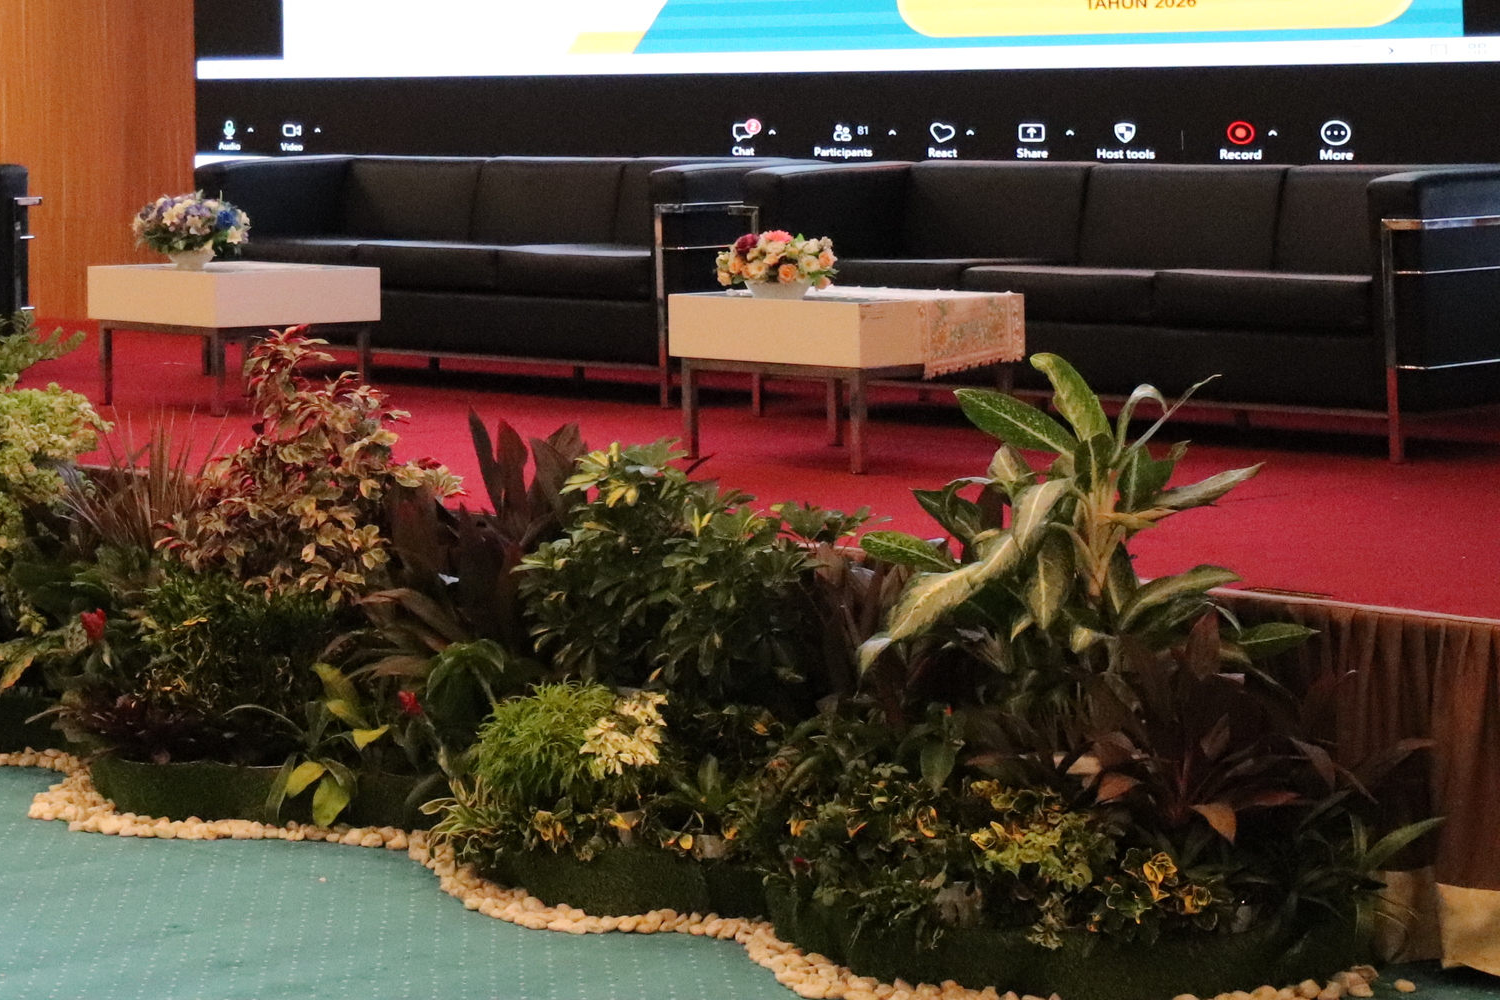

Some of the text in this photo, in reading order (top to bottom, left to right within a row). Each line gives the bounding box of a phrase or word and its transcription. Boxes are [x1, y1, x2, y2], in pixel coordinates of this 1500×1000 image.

[857, 126, 869, 135] 81
[218, 142, 241, 151] Audio
[280, 142, 303, 151] Video
[732, 146, 754, 157] Chat
[814, 146, 873, 158] Participants
[928, 147, 958, 158] React
[1016, 148, 1048, 159] Share
[1096, 148, 1155, 159] Host tools
[1219, 149, 1262, 160] Record
[1319, 149, 1354, 161] More
